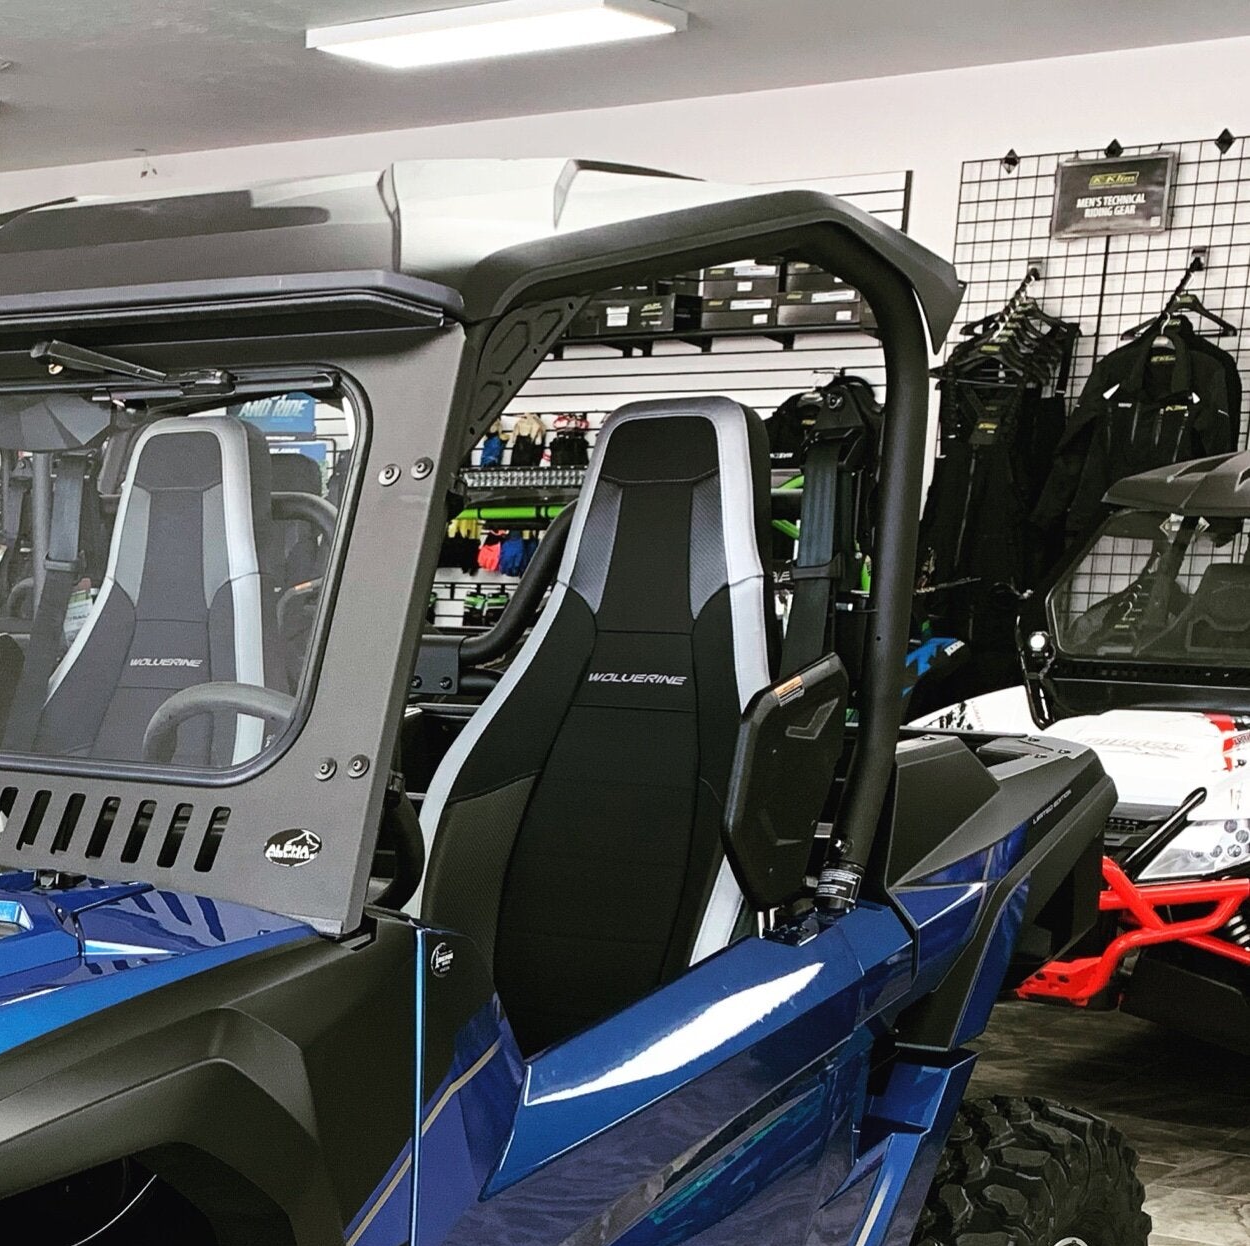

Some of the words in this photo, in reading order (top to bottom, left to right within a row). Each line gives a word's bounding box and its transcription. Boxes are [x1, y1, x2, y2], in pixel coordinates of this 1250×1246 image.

[1076, 195, 1103, 208] MEN'S
[1103, 193, 1146, 206] TECHNICAL
[1084, 206, 1113, 218] RIDING
[1113, 204, 1136, 215] GEAR
[238, 400, 273, 417] AND
[272, 400, 310, 417] RIDE
[265, 844, 310, 859] ALPHA
